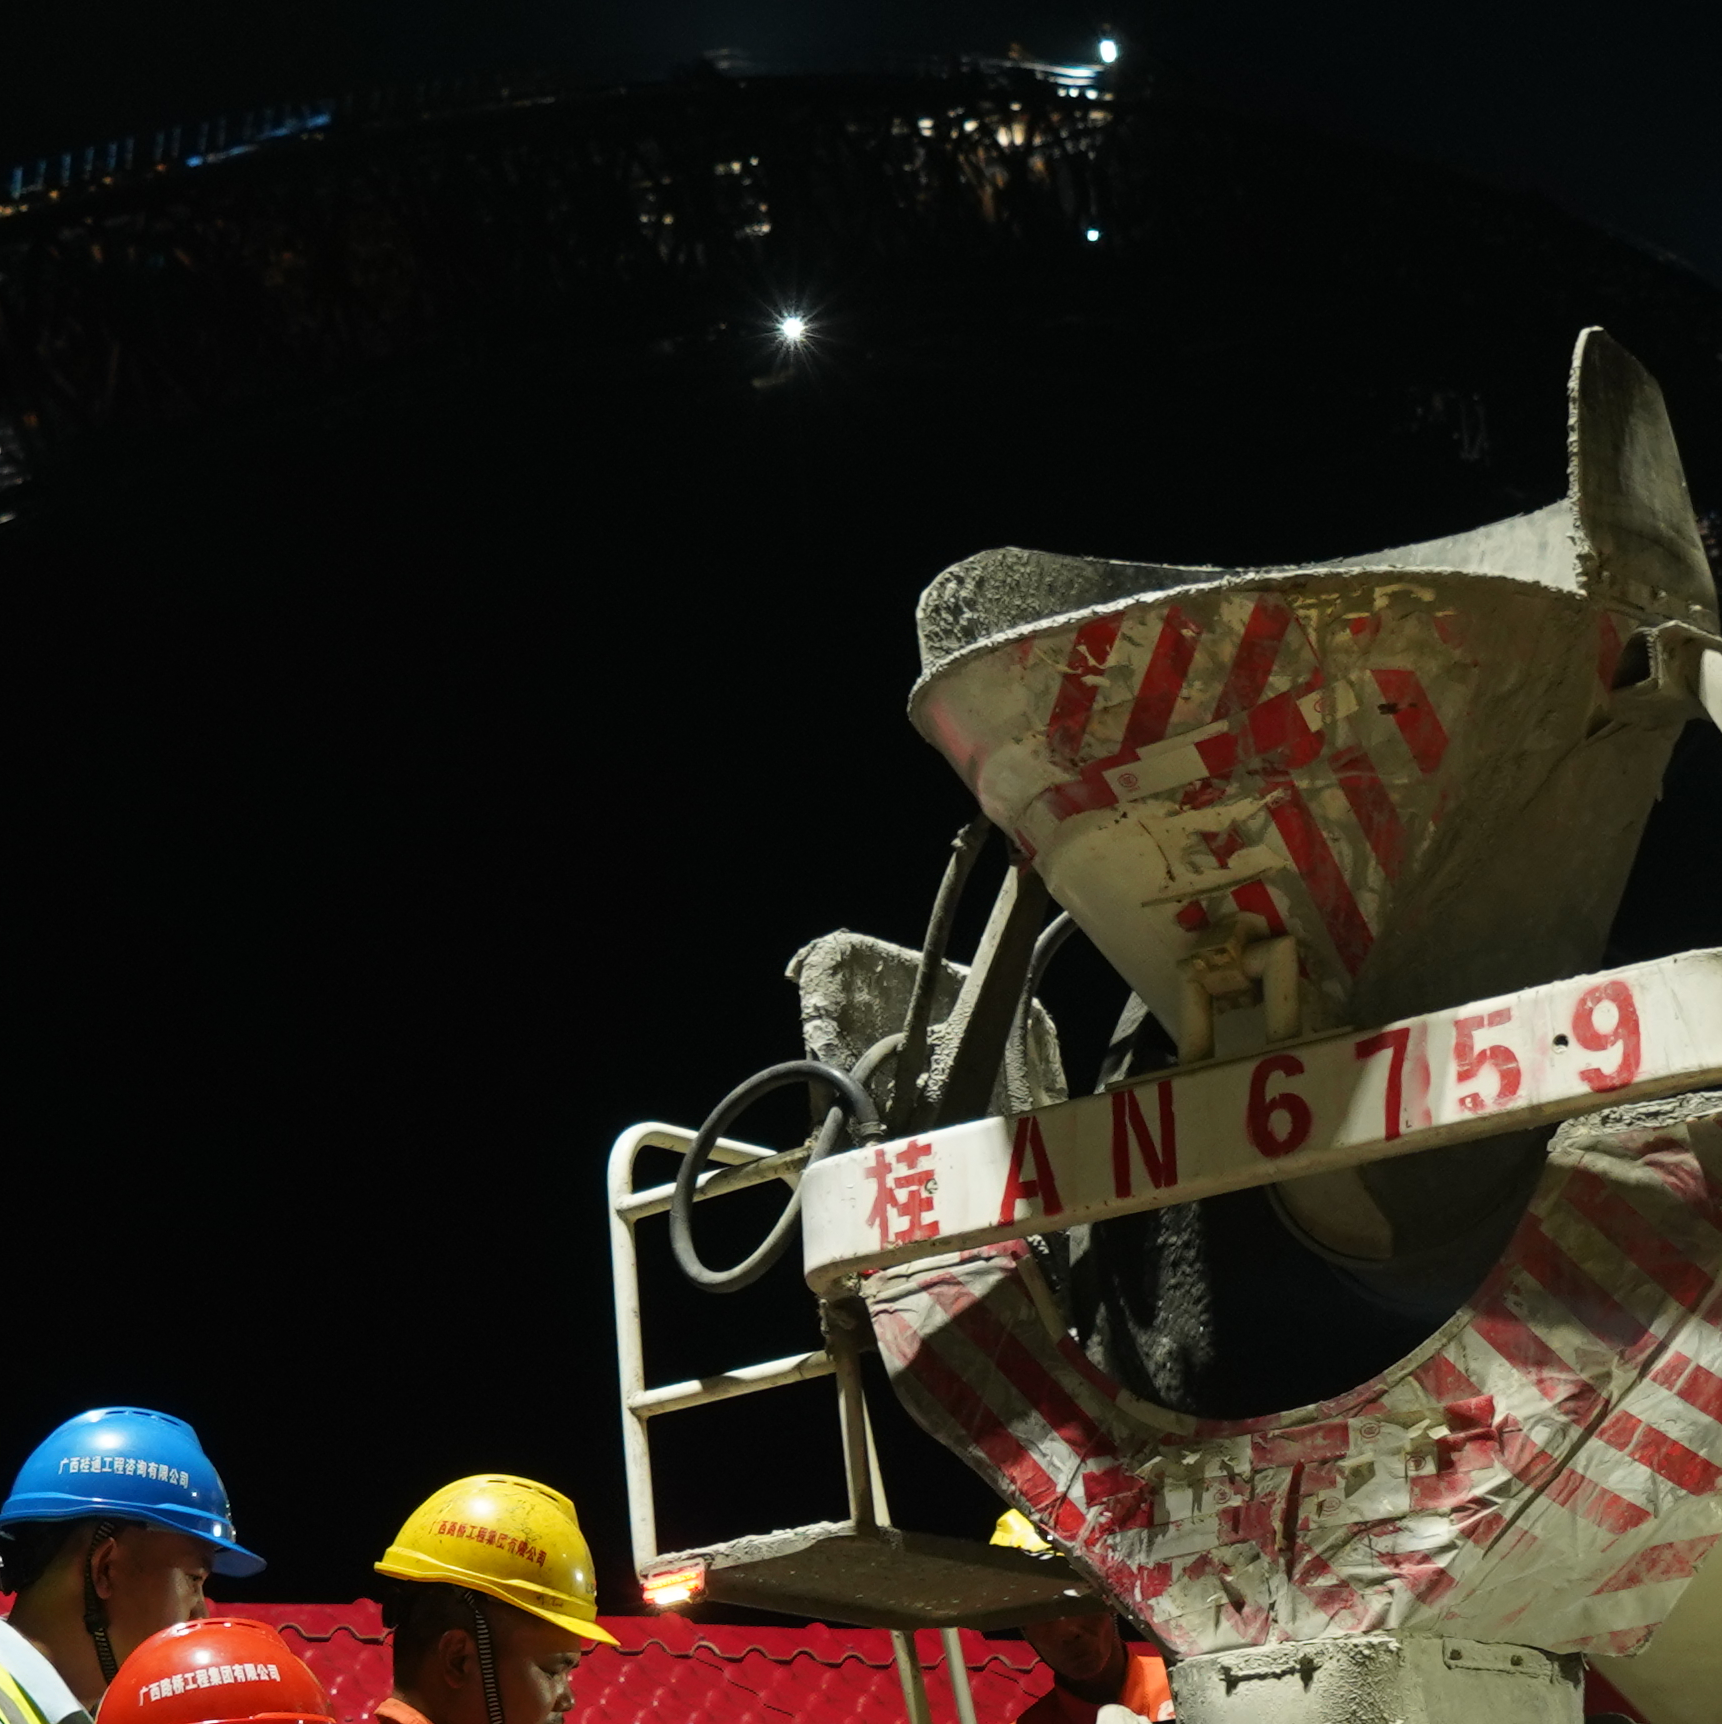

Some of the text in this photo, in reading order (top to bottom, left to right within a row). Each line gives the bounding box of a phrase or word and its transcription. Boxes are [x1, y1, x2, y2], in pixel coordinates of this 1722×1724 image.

[139, 1663, 281, 1706] 广西路桥工程集团有限公司
